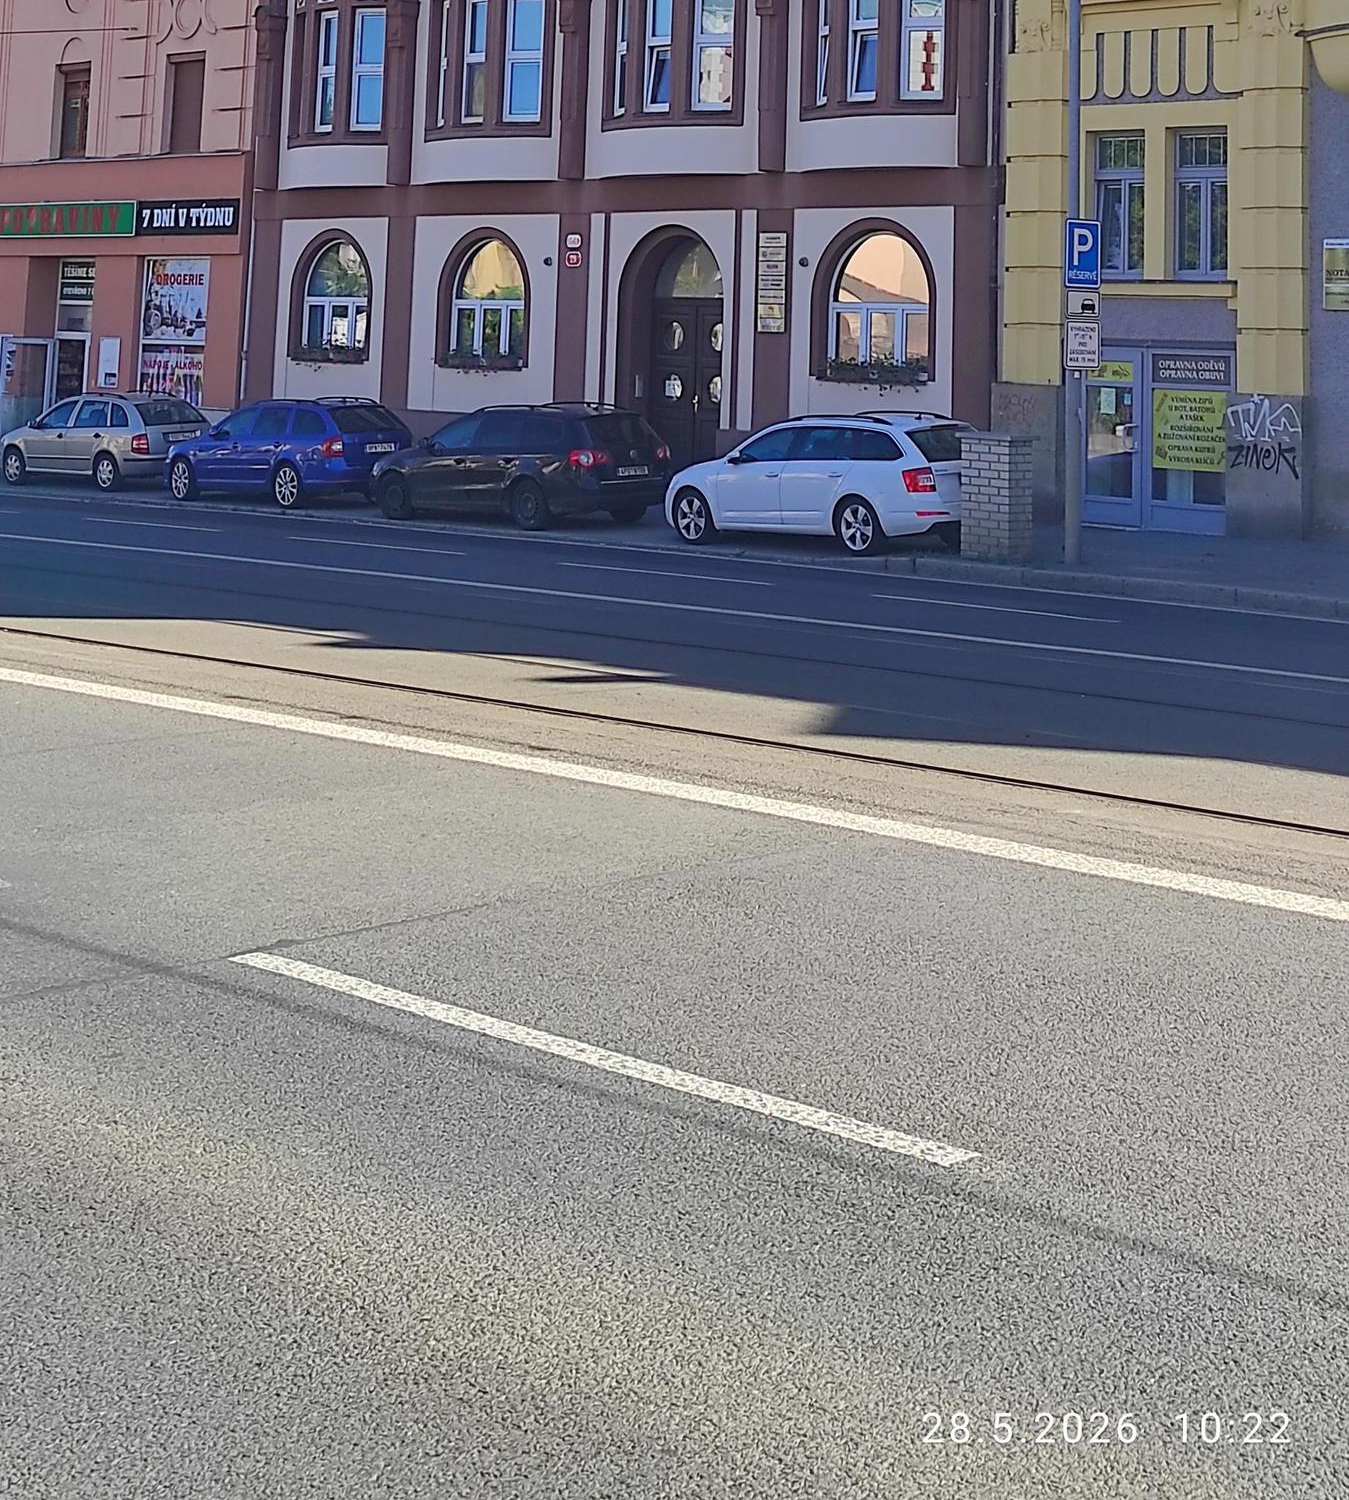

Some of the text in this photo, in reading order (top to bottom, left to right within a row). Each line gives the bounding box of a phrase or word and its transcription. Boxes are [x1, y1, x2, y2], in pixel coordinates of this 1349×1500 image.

[142, 203, 234, 227] 7 DNÍ V TÝDNU
[1073, 227, 1093, 266] P
[156, 273, 205, 286] DROGERIE
[1158, 360, 1197, 370] OPRAVNA
[1159, 369, 1224, 380] OPRAVNA OBUVI
